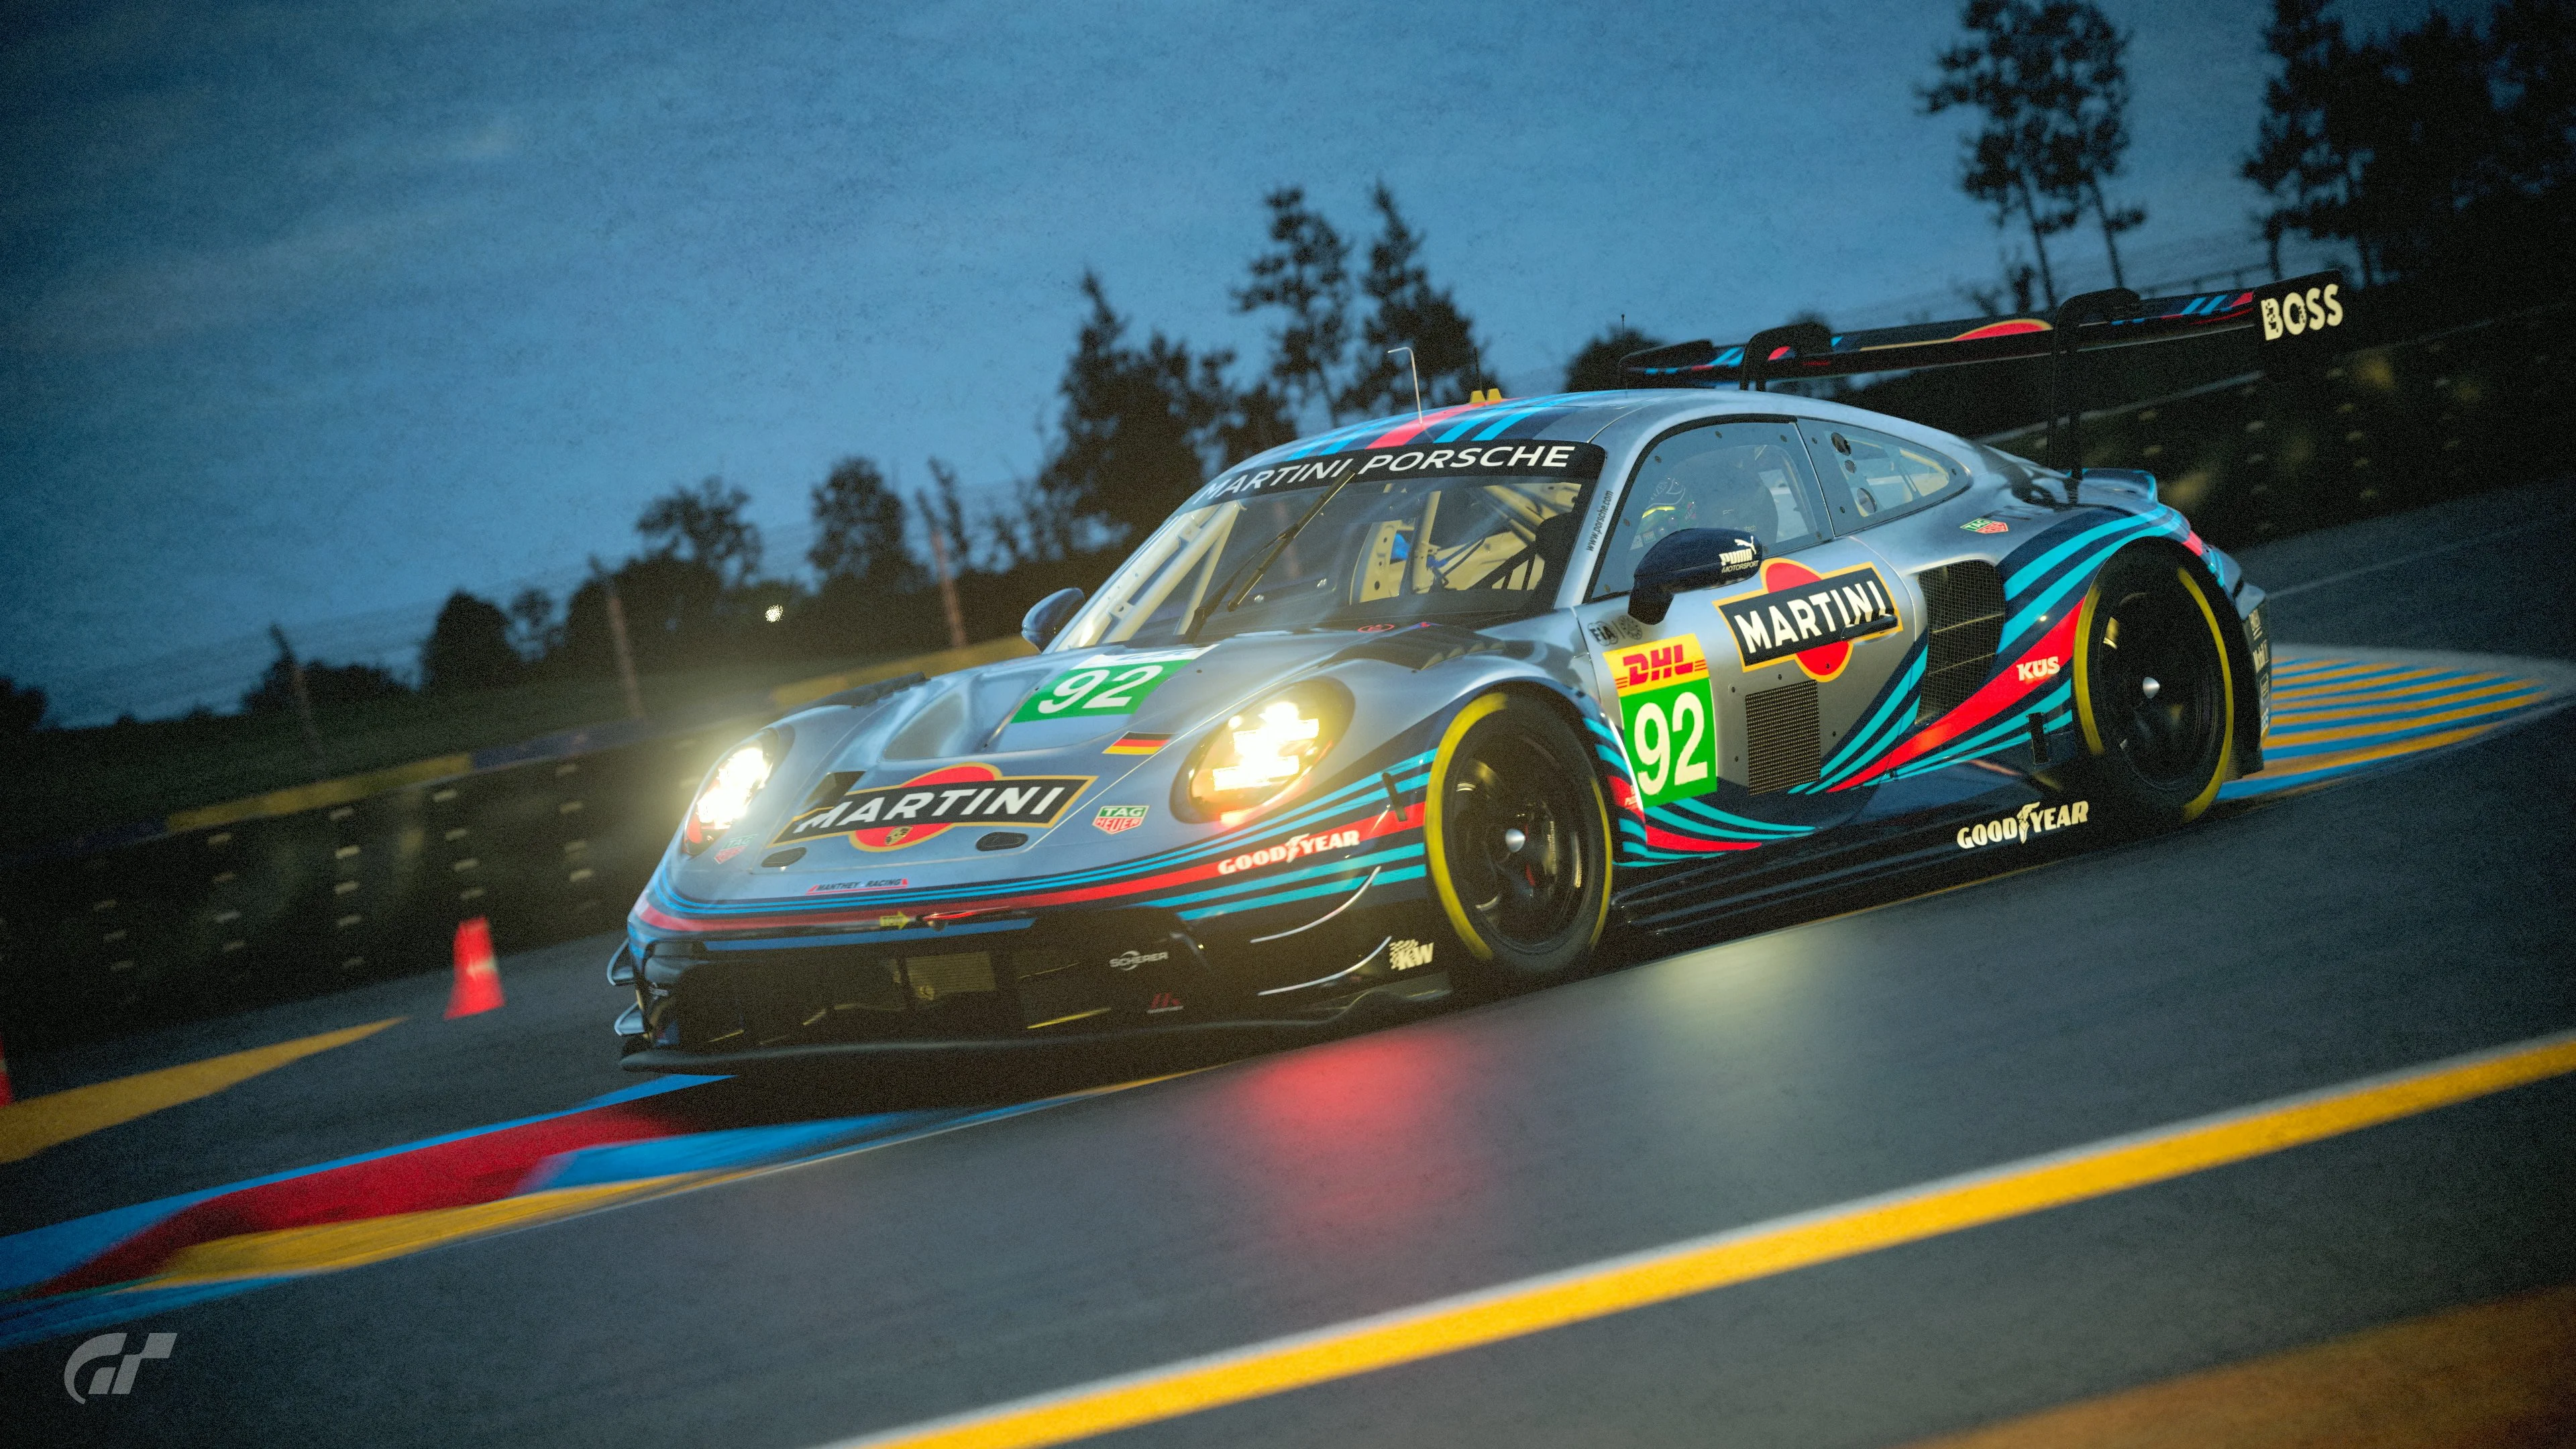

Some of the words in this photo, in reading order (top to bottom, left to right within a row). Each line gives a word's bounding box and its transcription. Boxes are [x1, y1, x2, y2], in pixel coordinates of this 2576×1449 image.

[2261, 284, 2343, 341] BOSS
[1193, 459, 1353, 504] MARTINI
[1358, 446, 1575, 475] PORSCHE
[1586, 490, 1613, 551] www.porsche.com
[1719, 548, 1753, 566] PUMA
[1721, 559, 1760, 574] MOTORSPORT
[1734, 580, 1886, 654] MARTINI
[1623, 644, 1694, 686] DHL
[1038, 665, 1163, 714] 92
[1634, 692, 1708, 796] 92
[793, 787, 1065, 834] MARTINI
[1096, 818, 1140, 832] HEUER
[1104, 808, 1144, 816] TAG
[1957, 800, 2089, 849] GOODYEAR
[1218, 830, 1360, 875] GOODYEAR
[816, 881, 861, 891] MANTHEY
[866, 879, 901, 887] RACING
[1398, 943, 1434, 971] KW
